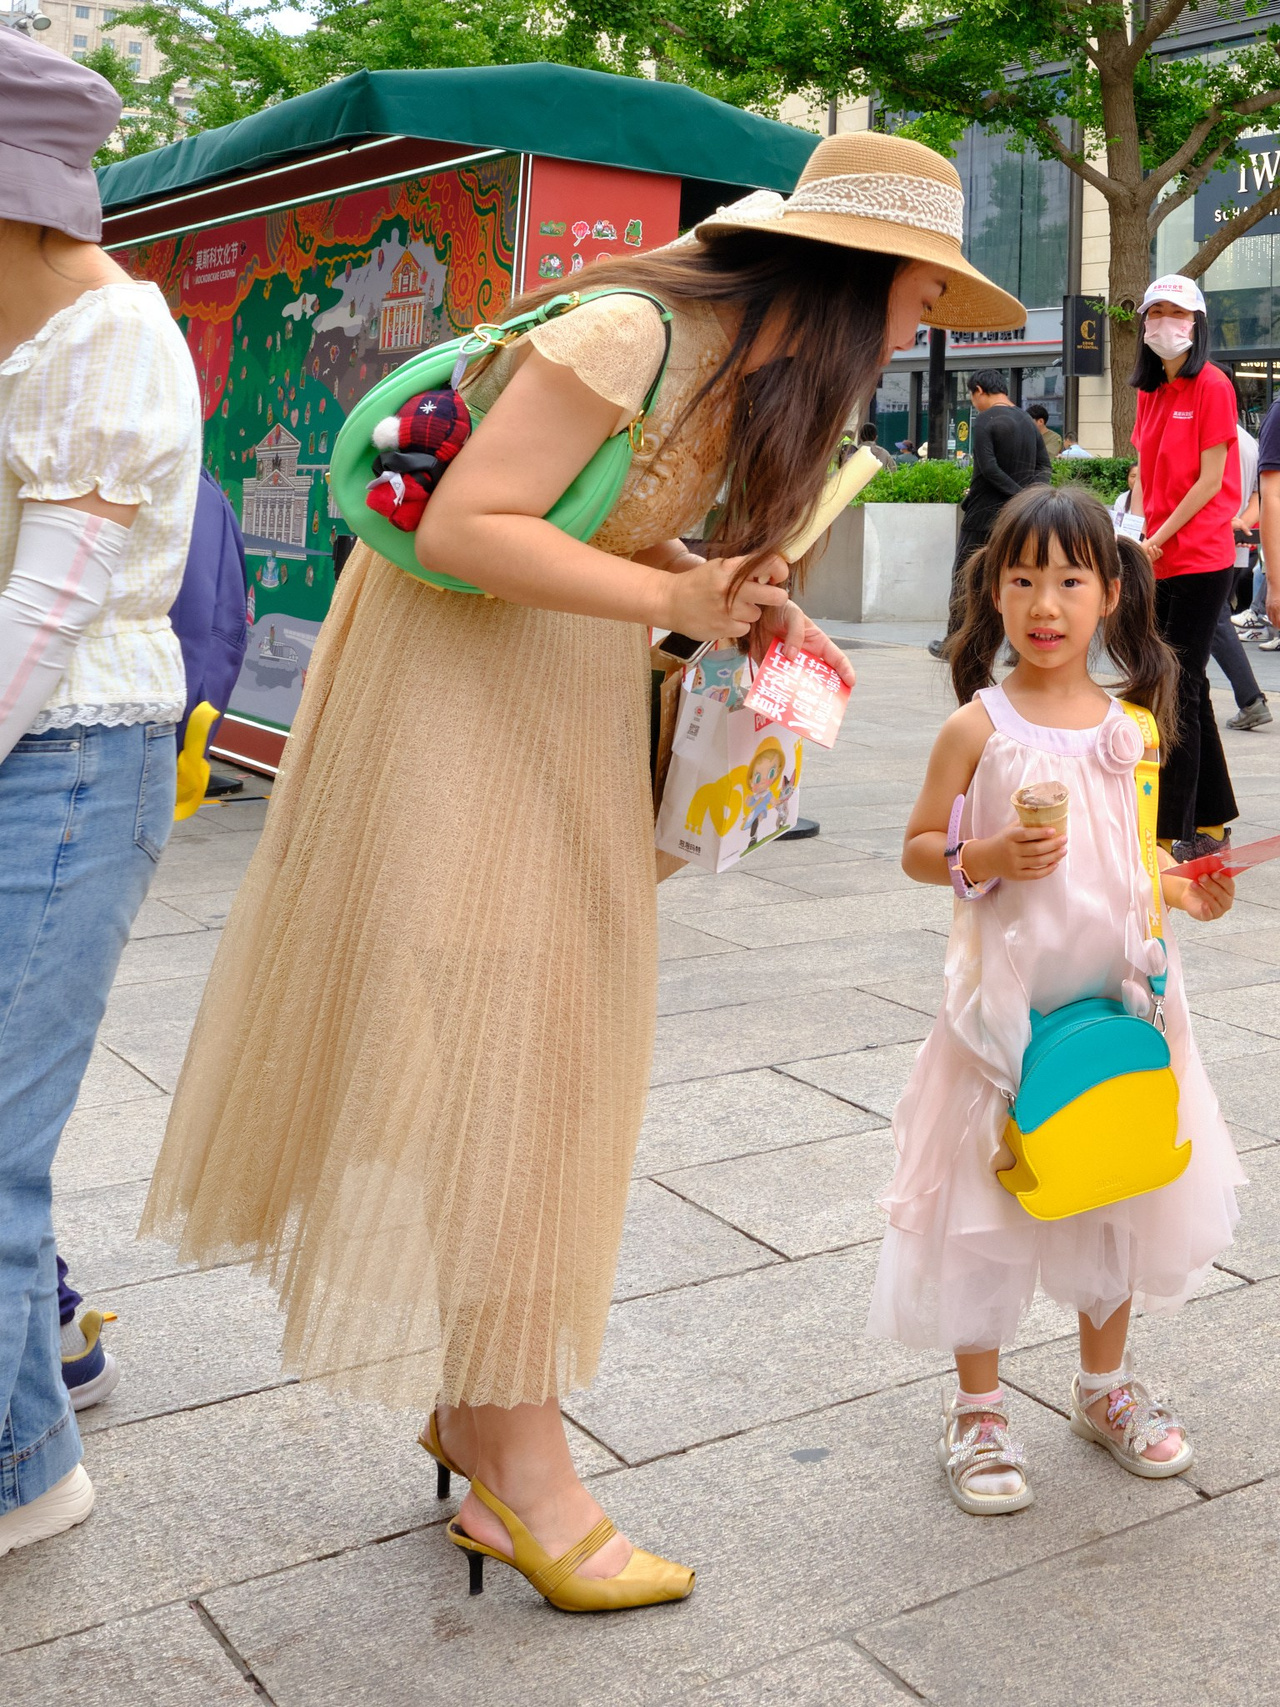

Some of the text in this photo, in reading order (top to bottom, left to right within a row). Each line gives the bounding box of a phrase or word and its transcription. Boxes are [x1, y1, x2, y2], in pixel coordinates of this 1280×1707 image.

[195, 241, 239, 271] 莫斯科文化节
[1135, 709, 1154, 745] MOLLY
[1145, 828, 1156, 878] MOLLY
